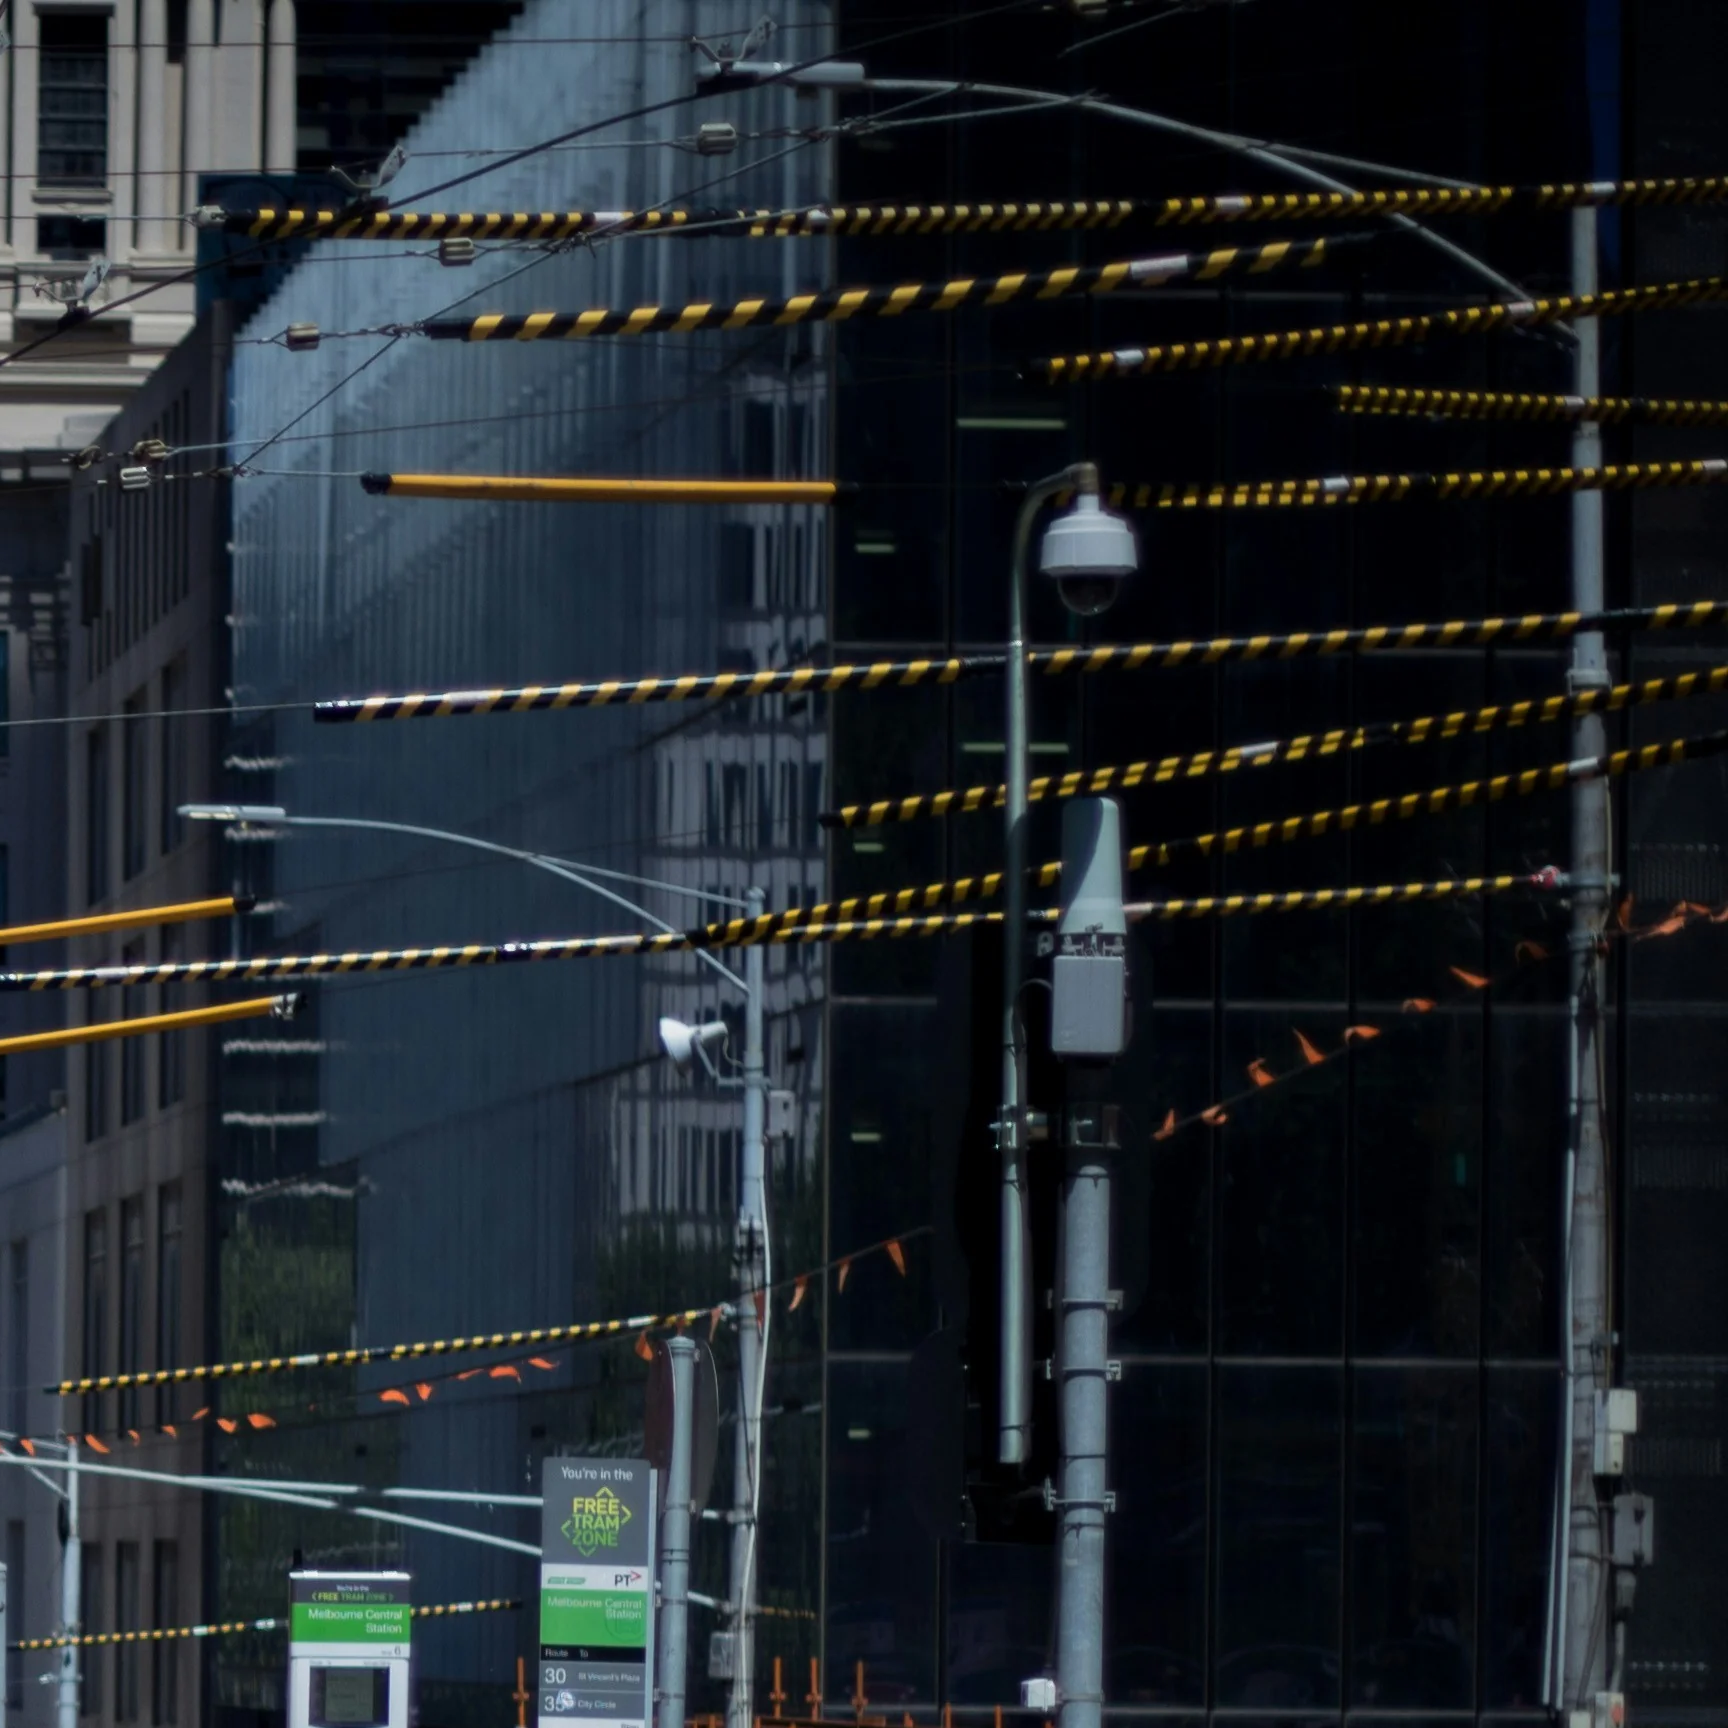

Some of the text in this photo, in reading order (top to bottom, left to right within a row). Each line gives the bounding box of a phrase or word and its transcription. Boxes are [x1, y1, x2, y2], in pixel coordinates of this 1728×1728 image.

[561, 1466, 634, 1481] You're in the
[573, 1497, 620, 1515] FREE
[573, 1514, 620, 1531] TRAM
[573, 1530, 619, 1547] ZONE
[318, 1592, 339, 1600] FREE
[547, 1596, 642, 1609] Melbourne Central
[308, 1608, 403, 1620] Melbourne Central
[605, 1609, 642, 1619] Station
[366, 1623, 402, 1633] Station
[545, 1649, 569, 1657] Route
[545, 1667, 567, 1684] 30
[578, 1700, 592, 1709] City
